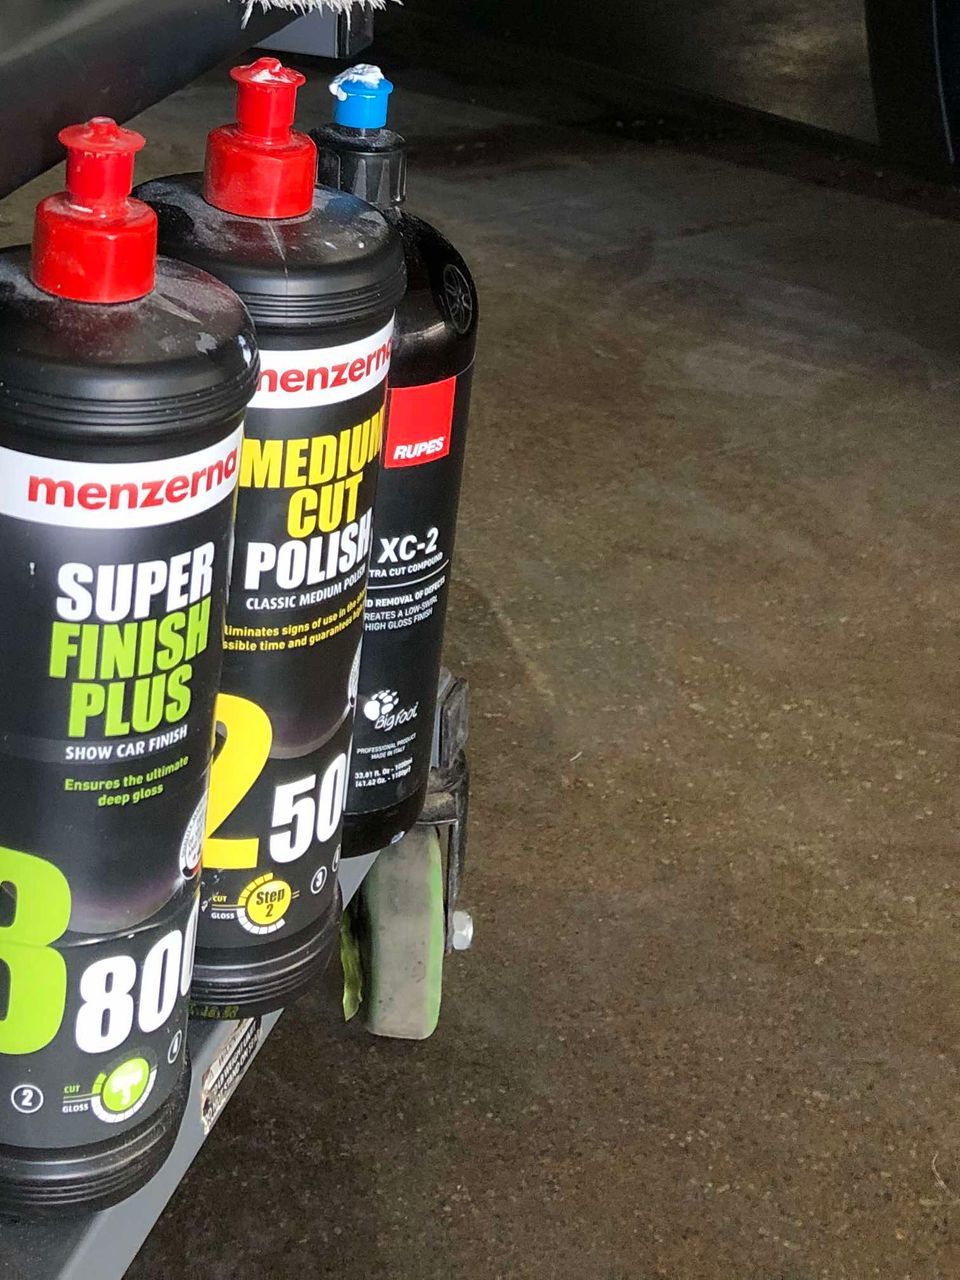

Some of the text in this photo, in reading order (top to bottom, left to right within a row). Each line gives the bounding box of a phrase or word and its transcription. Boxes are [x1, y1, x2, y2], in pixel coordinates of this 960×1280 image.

[393, 435, 445, 460] RUPES
[28, 447, 238, 510] menzerna
[287, 471, 364, 539] CUT
[244, 507, 371, 590] POLISH
[377, 527, 439, 564] XC-2
[369, 551, 443, 578] TRA CUT COMPOUND
[56, 541, 215, 622] SUPER
[246, 596, 297, 610] CLASSIC
[299, 582, 342, 606] MEDIUM
[375, 594, 414, 607] REMOVAL
[415, 590, 424, 600] OF
[224, 624, 279, 637] liminates
[282, 620, 310, 636] signs
[312, 617, 323, 629] of
[323, 612, 338, 625] use
[339, 608, 347, 618] in
[364, 611, 396, 621] REATES
[397, 609, 403, 618] A
[365, 607, 433, 632] HIGH GLOSS FINISH
[49, 596, 212, 680] FINISH
[222, 640, 258, 651] ssible
[259, 638, 286, 650] time
[288, 635, 308, 648] and
[309, 616, 353, 646] guarantees
[68, 663, 193, 738] PLUS
[65, 724, 188, 760] SHOW CAR FINISH
[356, 742, 397, 754] PROFESSIONAL
[371, 751, 386, 760] MADE
[393, 745, 406, 755] ITALY
[64, 756, 189, 791] Ensures the ultimate
[98, 784, 164, 808] deep gloss
[212, 895, 228, 903] CUT
[256, 888, 285, 906] Step
[211, 912, 235, 920] GLOSS
[265, 903, 274, 918] 2
[22, 1089, 33, 1107] 2
[64, 1085, 80, 1094] CUT
[62, 1102, 89, 1113] GLOSS
